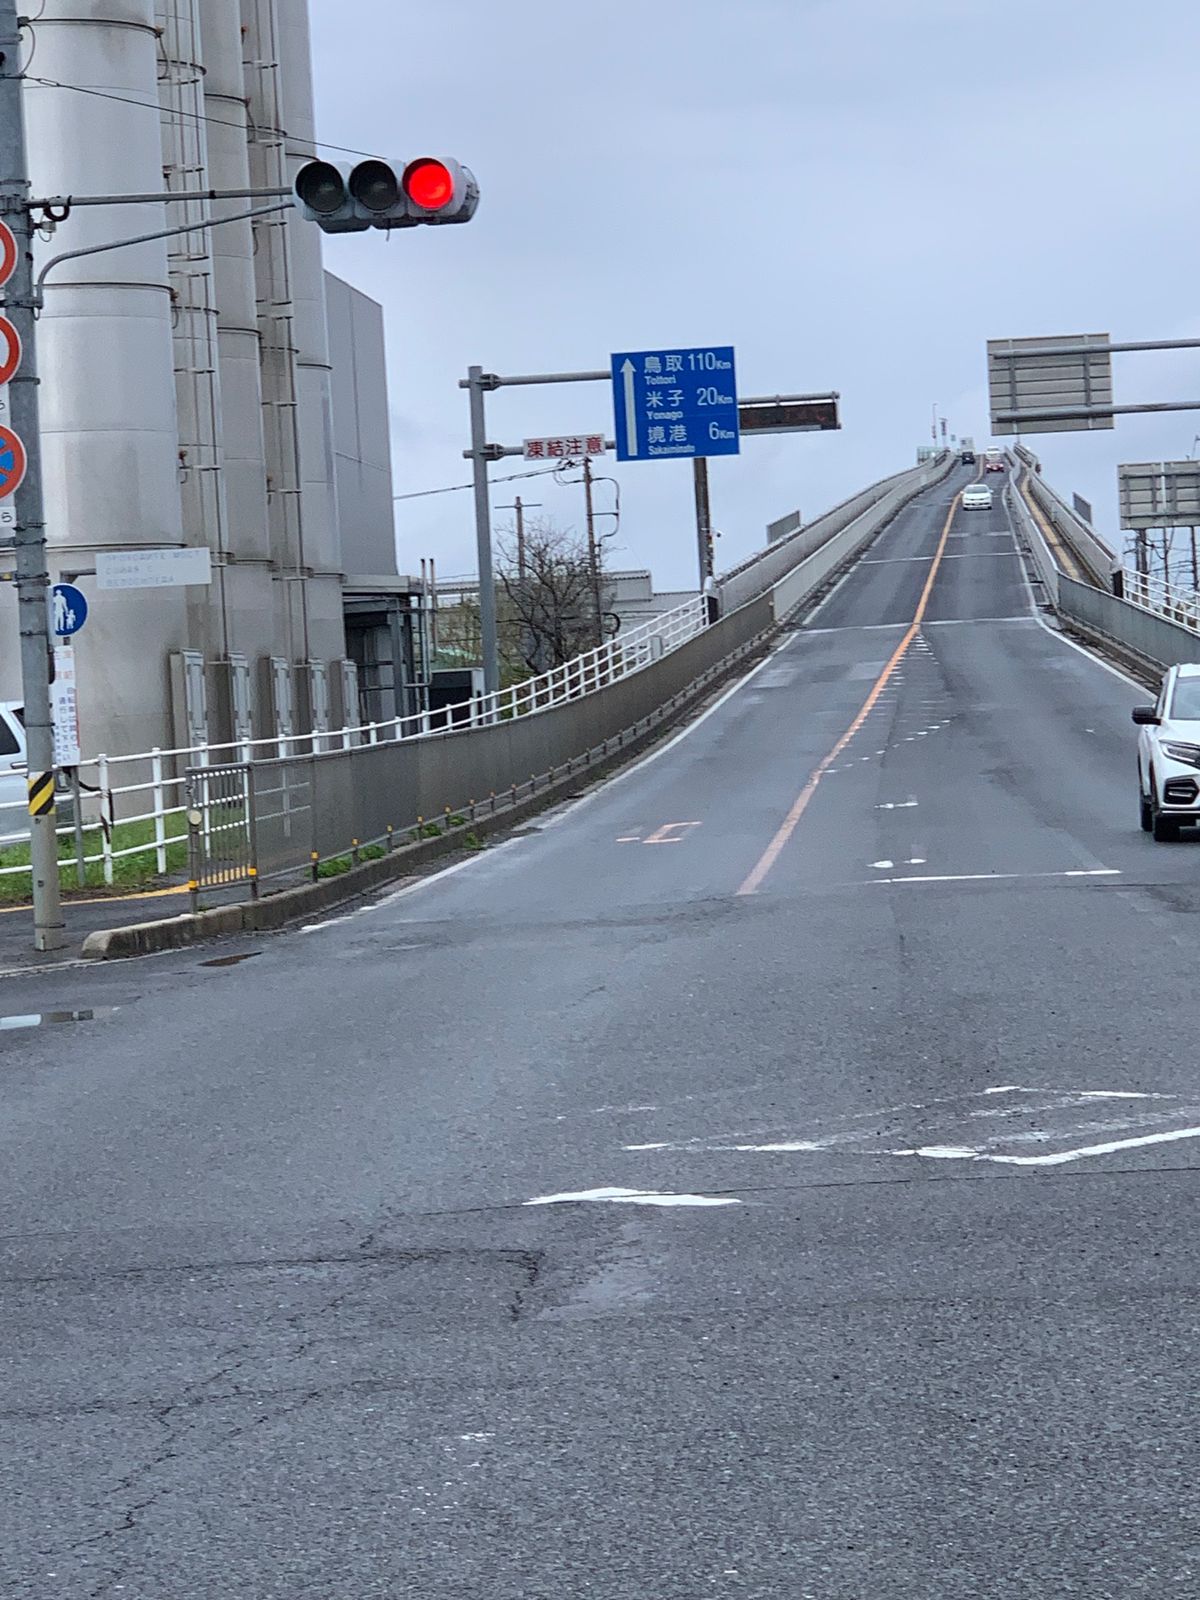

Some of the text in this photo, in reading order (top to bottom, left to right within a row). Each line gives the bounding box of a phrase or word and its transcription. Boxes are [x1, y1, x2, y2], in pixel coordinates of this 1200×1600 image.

[644, 355, 684, 373] 鳥取
[644, 375, 677, 384] Tottori
[646, 389, 684, 407] 米子
[646, 411, 684, 420] Yonago
[648, 424, 687, 443] 境港
[527, 436, 602, 457] 凍結注意
